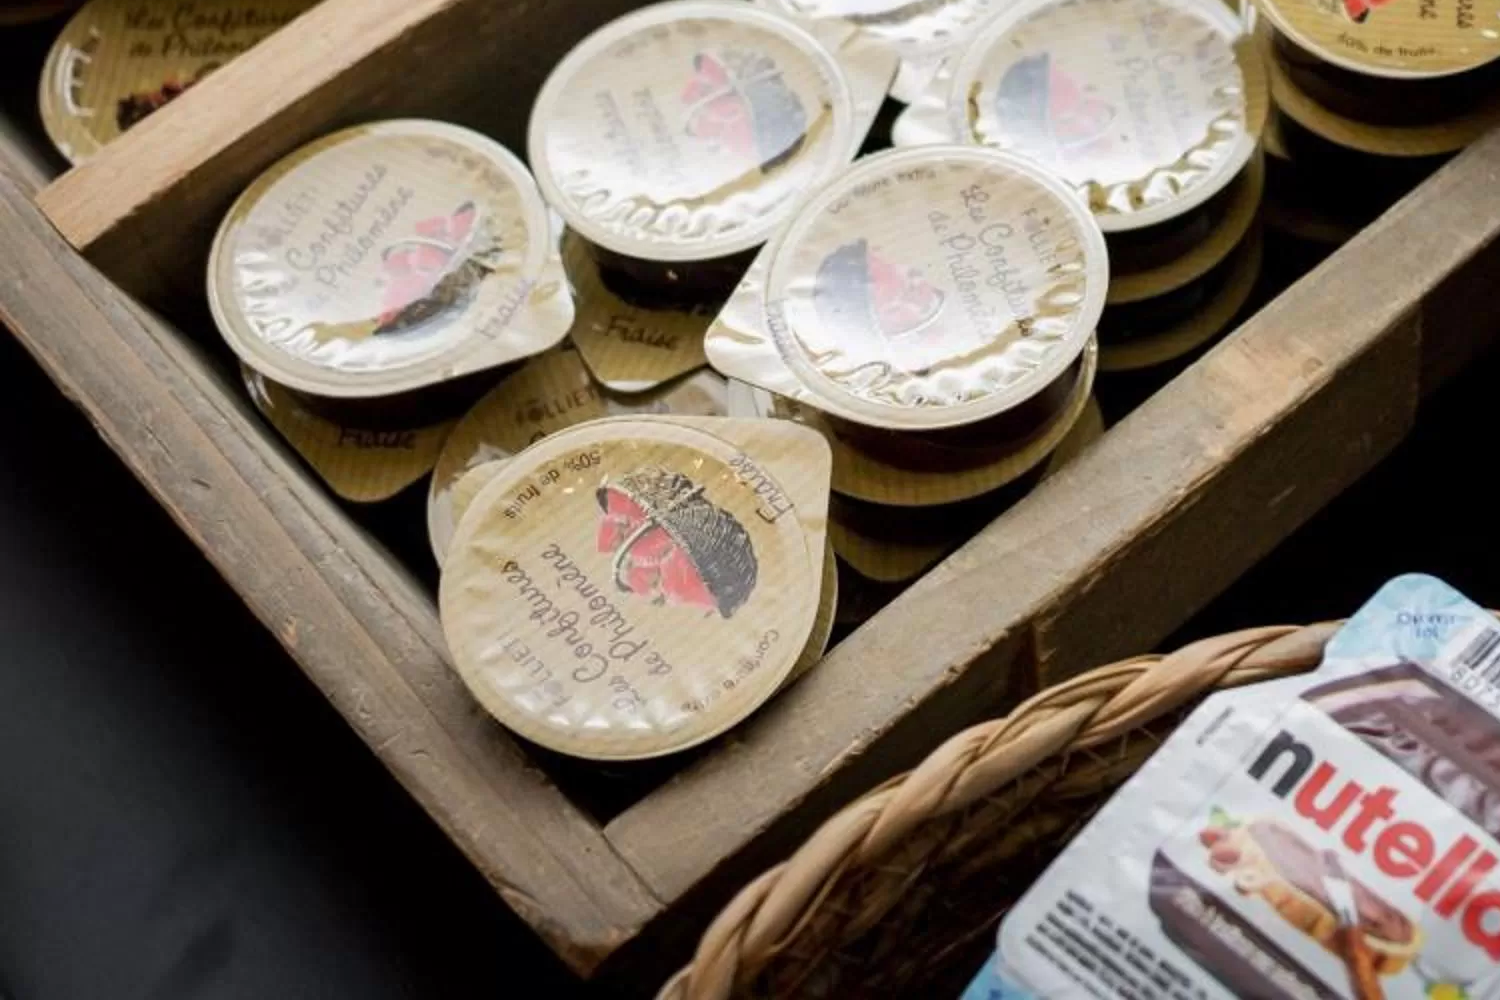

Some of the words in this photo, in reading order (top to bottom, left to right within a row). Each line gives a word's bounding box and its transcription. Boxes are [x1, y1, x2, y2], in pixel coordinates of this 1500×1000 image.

[284, 163, 390, 274] Confitures
[606, 314, 681, 353] Fraise
[539, 471, 560, 487] de
[564, 450, 601, 473] 50%
[502, 486, 542, 521] fruits
[728, 452, 797, 525] Fraise
[502, 559, 609, 685] Confitures
[543, 543, 648, 663] Philomène
[645, 650, 673, 678] de
